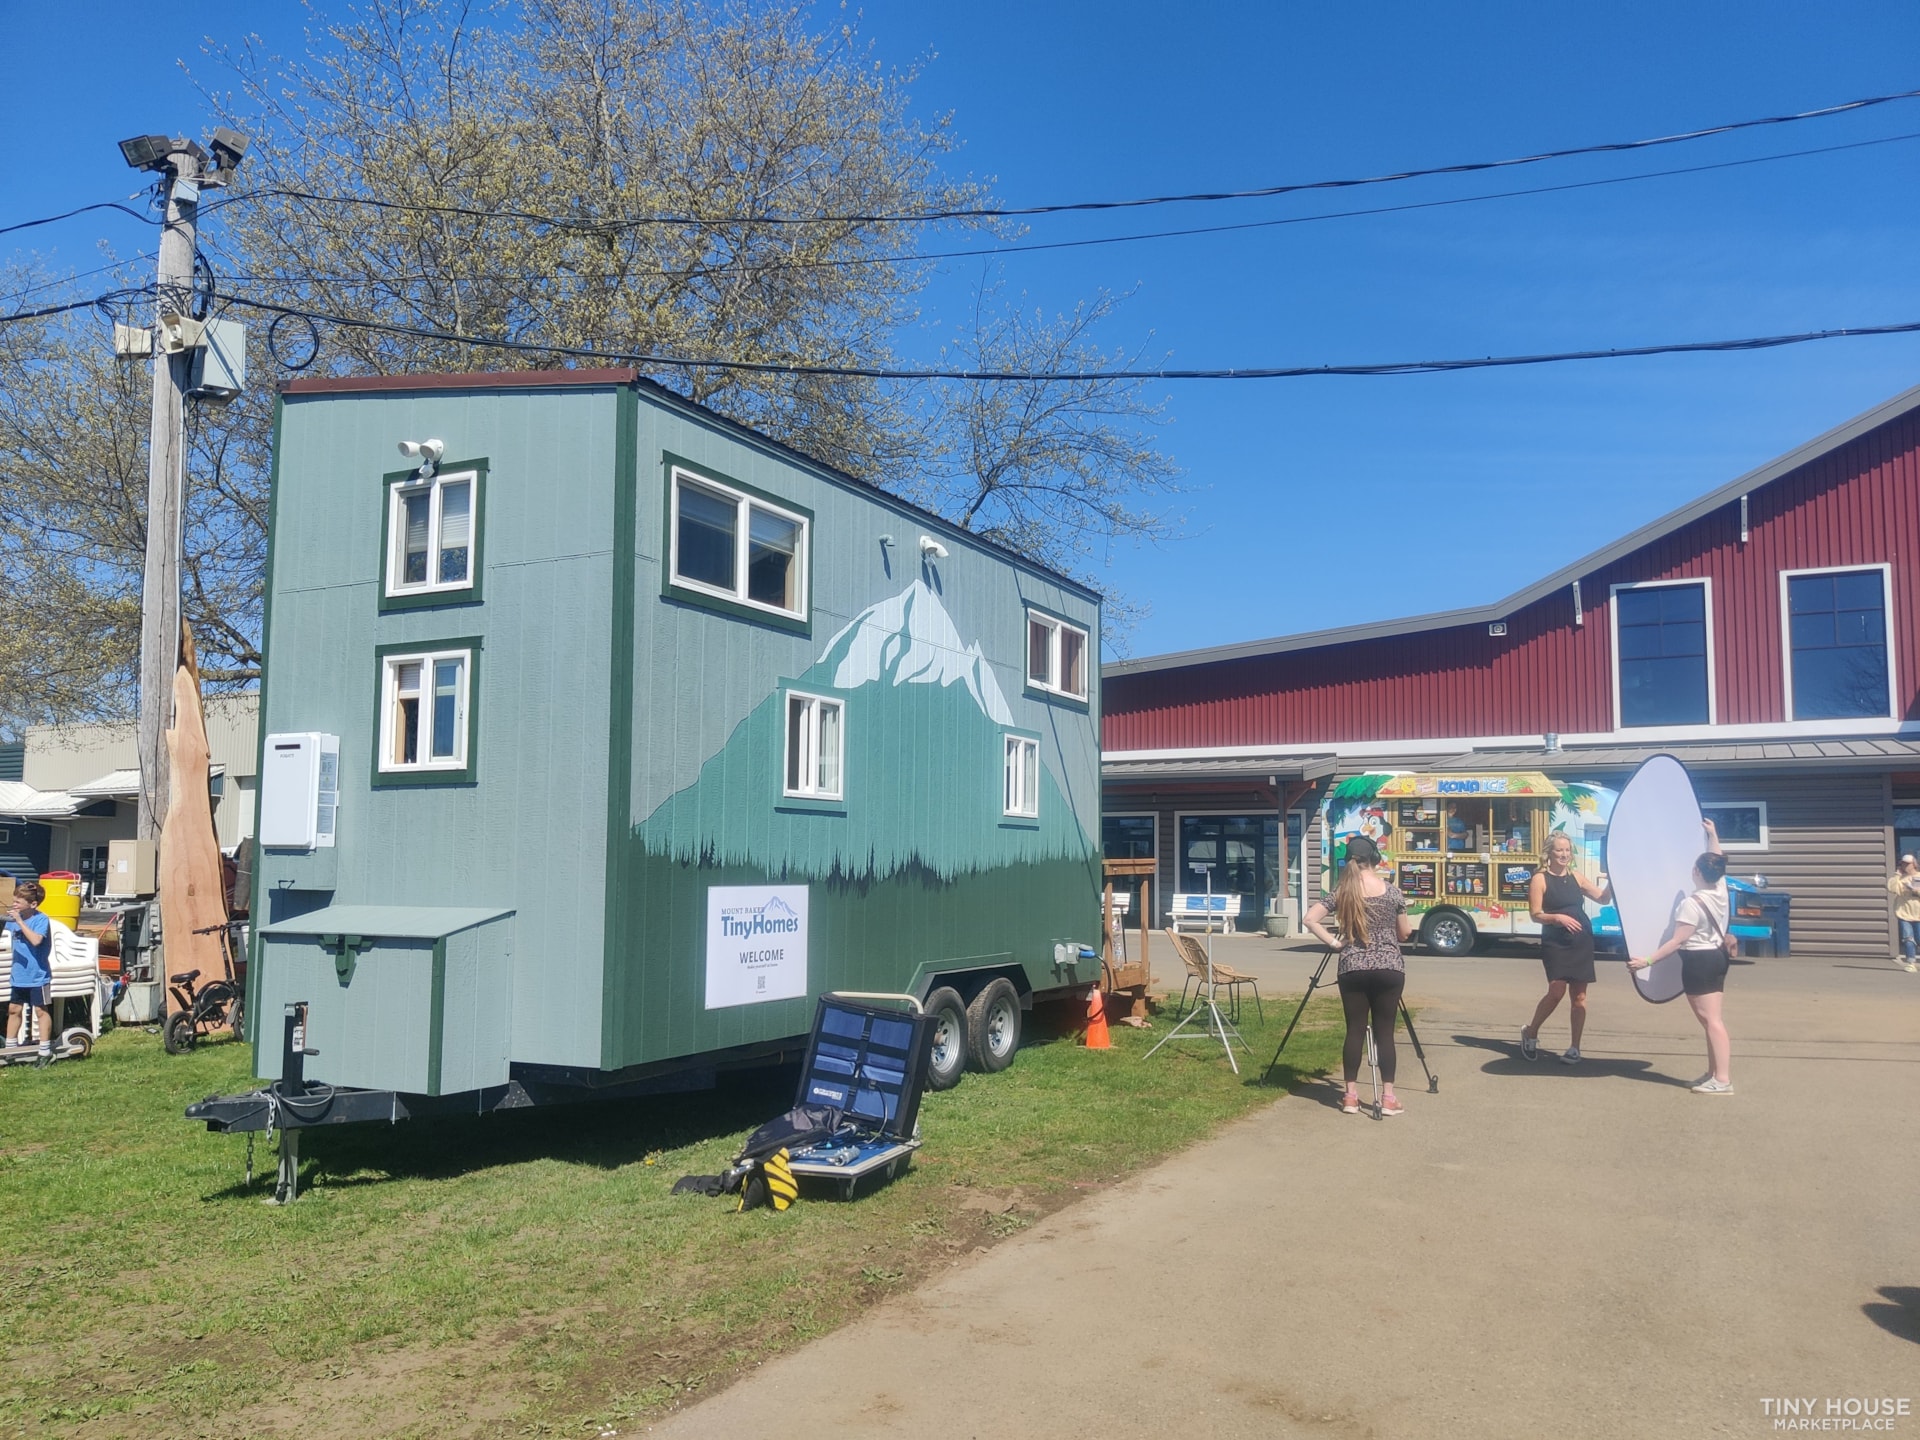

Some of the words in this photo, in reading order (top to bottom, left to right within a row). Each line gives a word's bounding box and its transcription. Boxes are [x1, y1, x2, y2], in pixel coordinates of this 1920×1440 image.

[1437, 778, 1480, 794] KONA
[1481, 778, 1508, 794] ICE
[721, 914, 799, 940] TinyHomes
[739, 949, 784, 964] WELCOME
